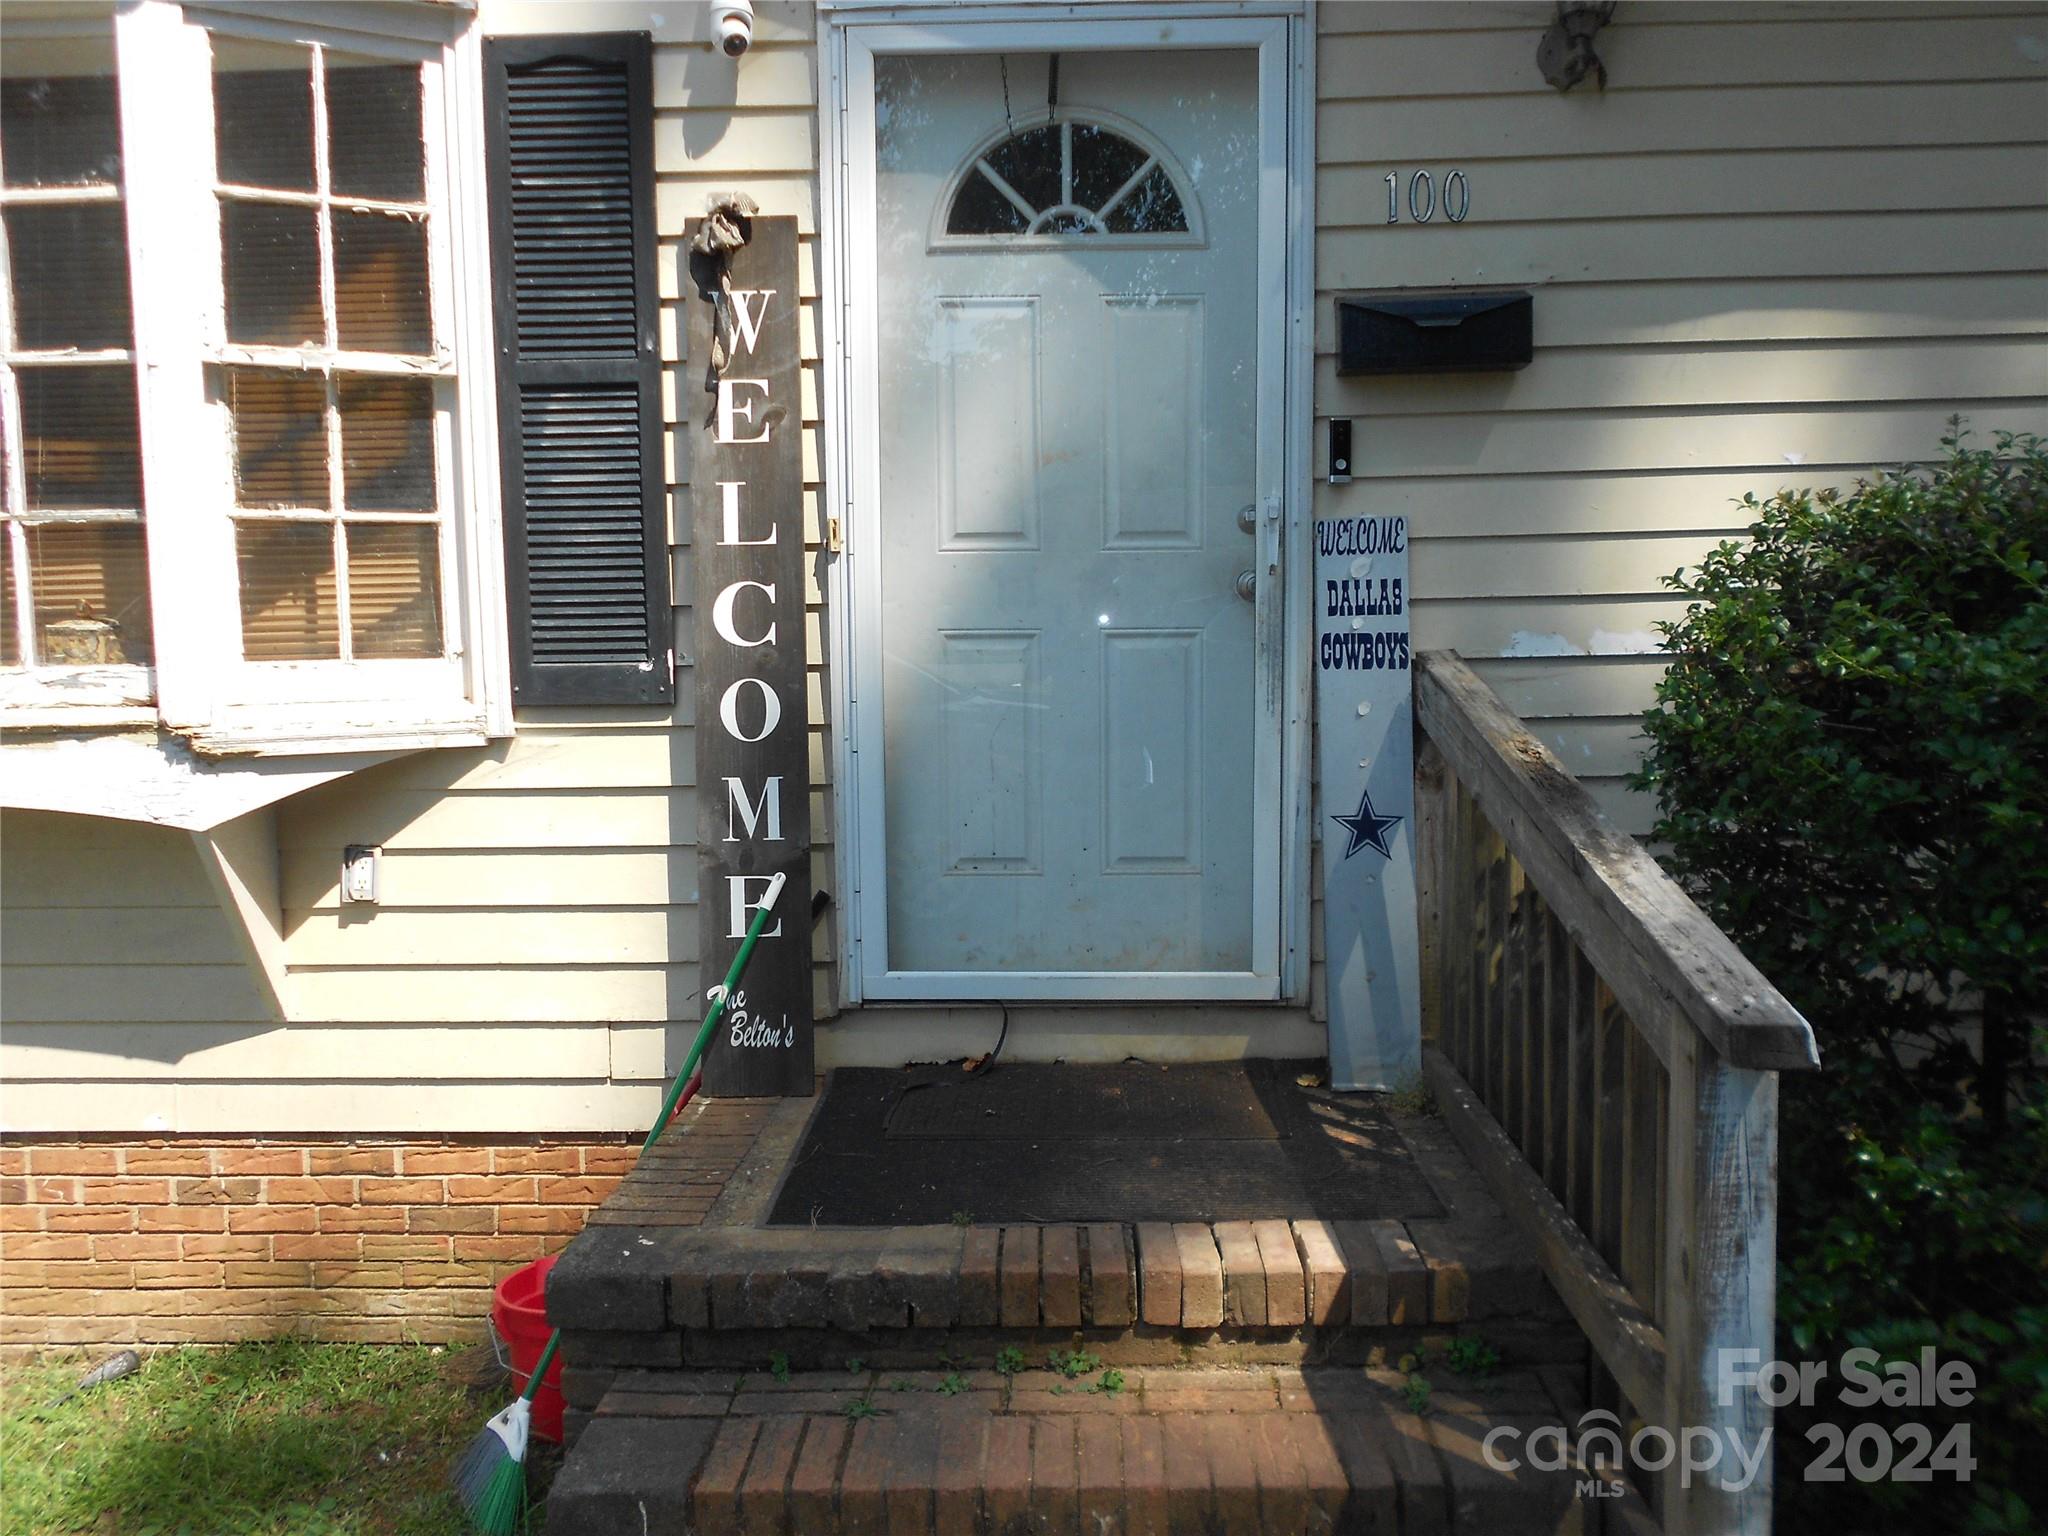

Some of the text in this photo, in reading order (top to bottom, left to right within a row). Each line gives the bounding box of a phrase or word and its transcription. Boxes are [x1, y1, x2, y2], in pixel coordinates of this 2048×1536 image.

[1384, 168, 1470, 224] 100
[1317, 518, 1405, 557] WELCOME
[708, 289, 785, 939] WELCOME
[1327, 578, 1403, 617] DALLAS
[1321, 632, 1409, 670] COWBOYS
[730, 1010, 794, 1049] Belton's
